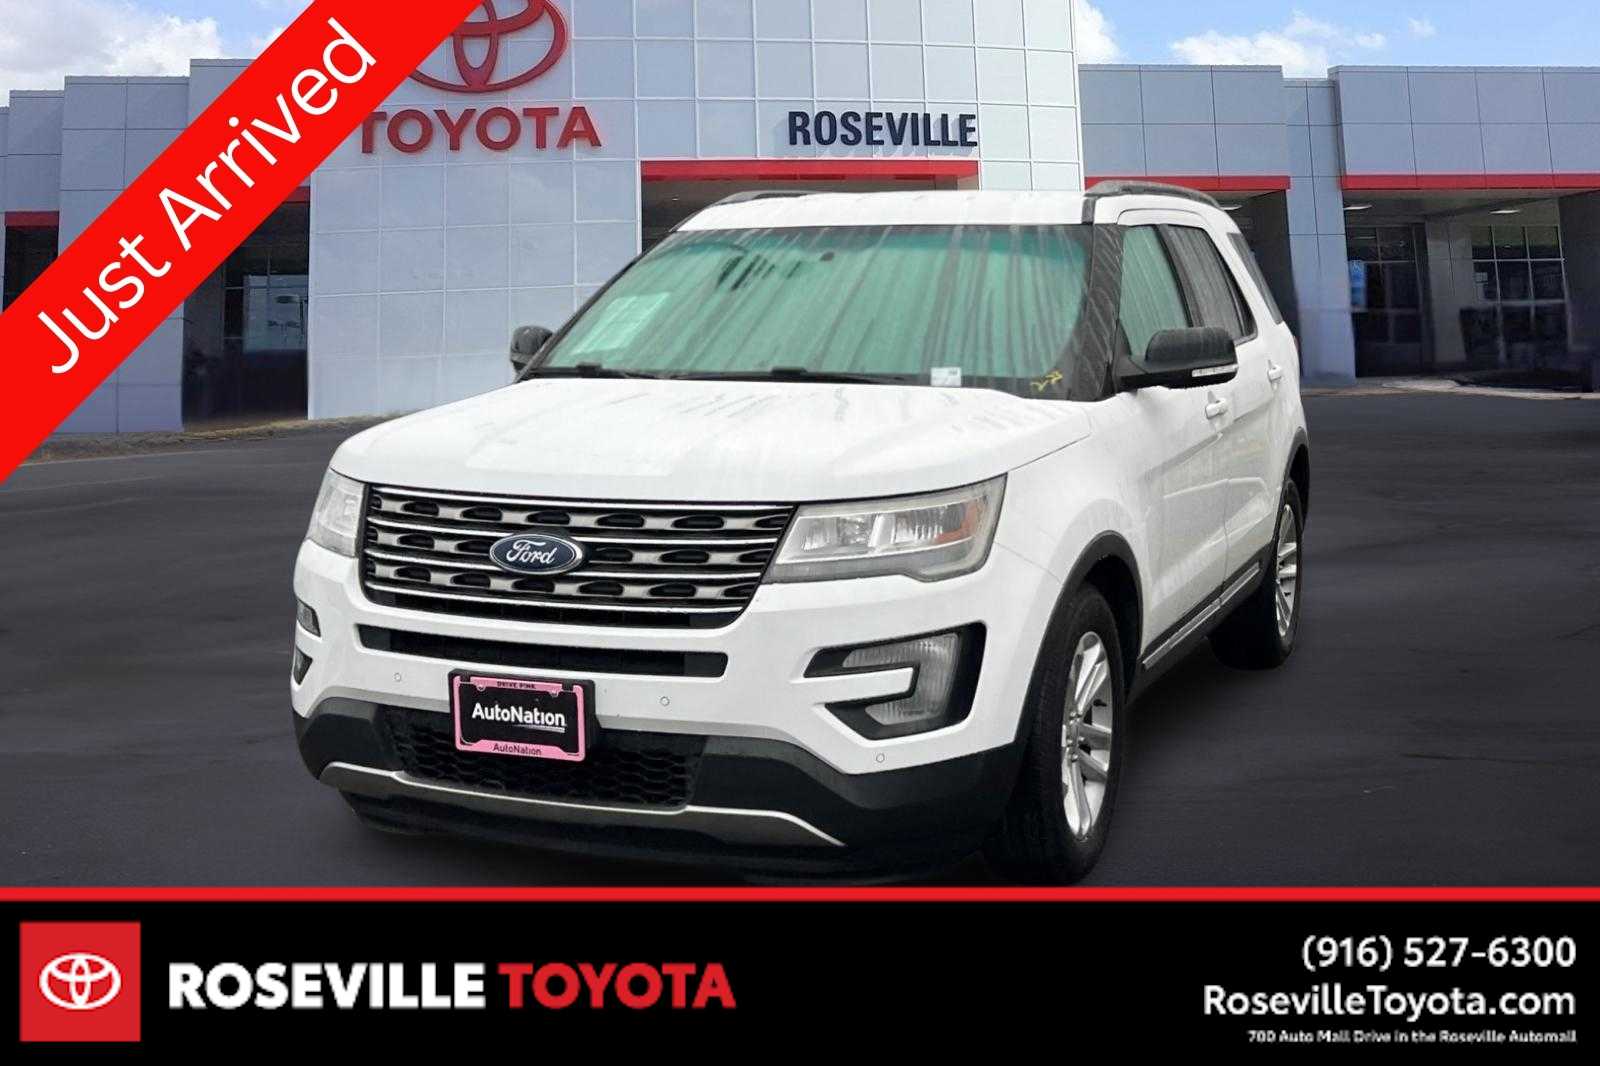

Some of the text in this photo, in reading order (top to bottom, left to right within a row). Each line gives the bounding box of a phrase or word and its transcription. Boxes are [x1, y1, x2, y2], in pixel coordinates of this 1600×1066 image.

[359, 105, 602, 154] TOYOTA
[788, 110, 978, 147] ROSEVILLE
[505, 538, 558, 564] Ford
[471, 701, 566, 728] AutoNation
[492, 742, 542, 756] AutoNation
